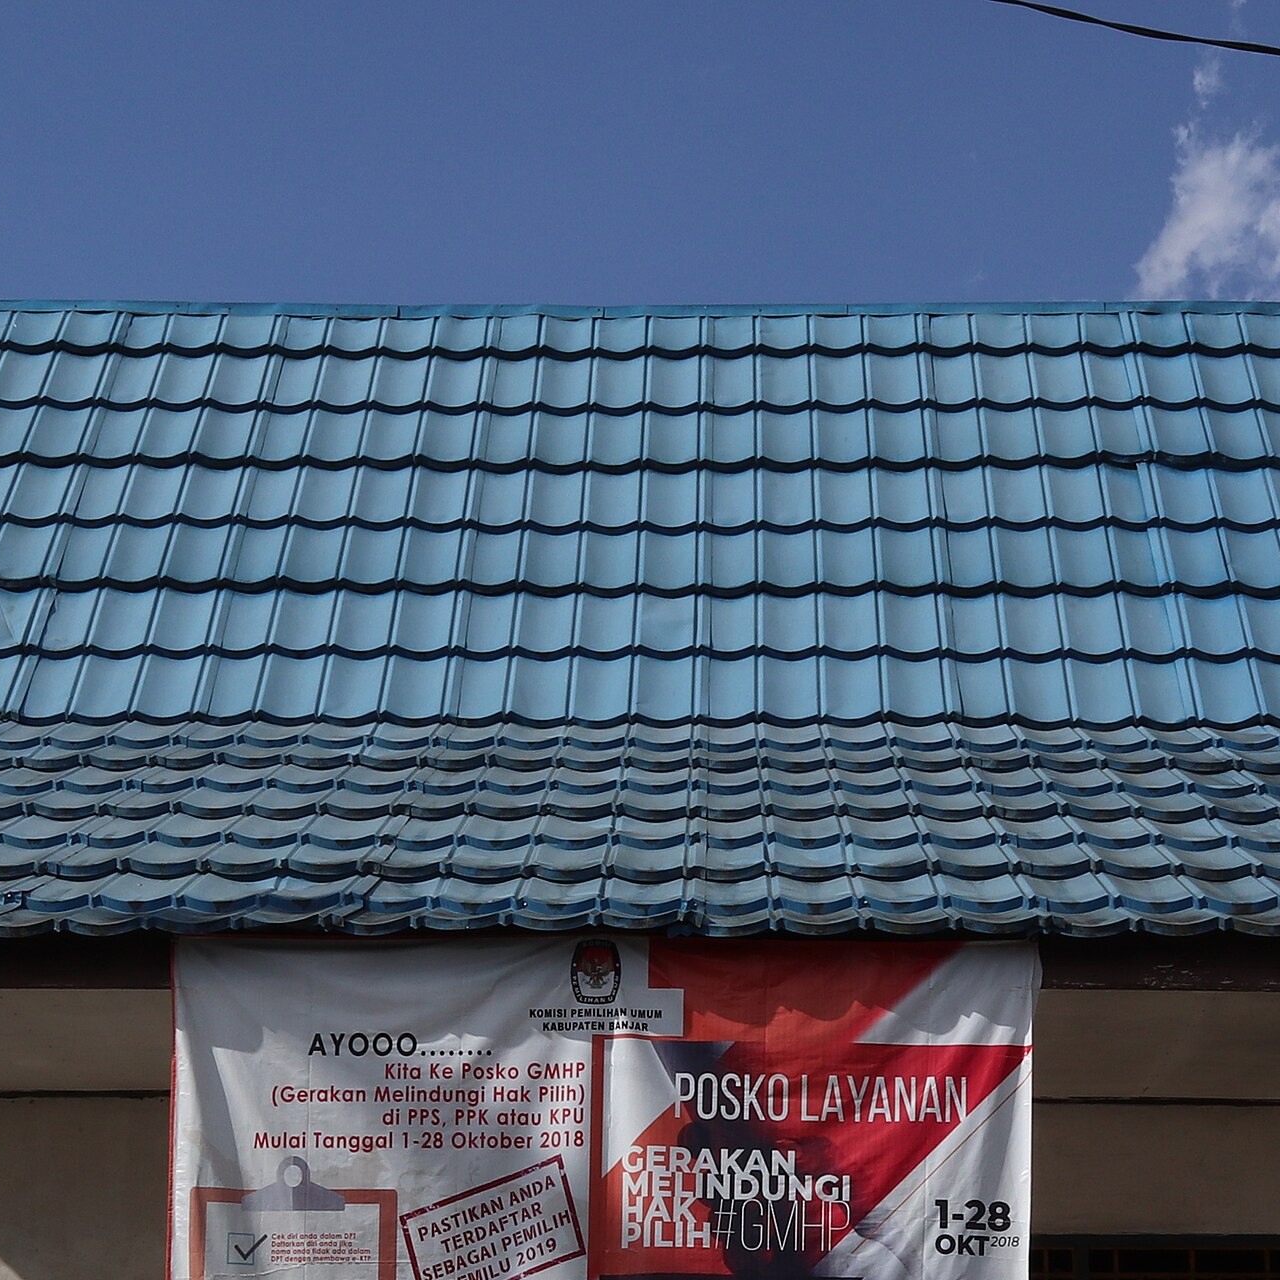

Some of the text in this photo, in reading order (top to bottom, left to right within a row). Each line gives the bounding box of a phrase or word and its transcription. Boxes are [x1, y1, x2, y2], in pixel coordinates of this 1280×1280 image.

[529, 1007, 662, 1019] KOMISI PEMILIHAN UMUM
[542, 1020, 649, 1032] KABUPATEN BANJAR
[385, 1062, 586, 1080] Kita Ke Posko GMHP
[272, 1084, 586, 1107] (Gerakan Melindungi Hak Pilih)
[674, 1072, 967, 1124] POSKO LAYANAN
[383, 1108, 585, 1128] di PPS, PPK atau KPU
[253, 1131, 585, 1153] Mulai Tanggal 1-28 Oktober 2018
[622, 1145, 796, 1177] GERAKAN
[622, 1170, 851, 1203] MELINDUNGI
[417, 1175, 557, 1242] PASTIKAN ANDA
[622, 1195, 697, 1223] HAK
[935, 1199, 1011, 1233] 1-28
[440, 1201, 543, 1254] TERDAFTAR
[502, 1209, 571, 1252] PEMILIH
[621, 1199, 852, 1252] PILIH #GMHP
[517, 1237, 557, 1267] 2019
[935, 1235, 1020, 1257] OKT 2018
